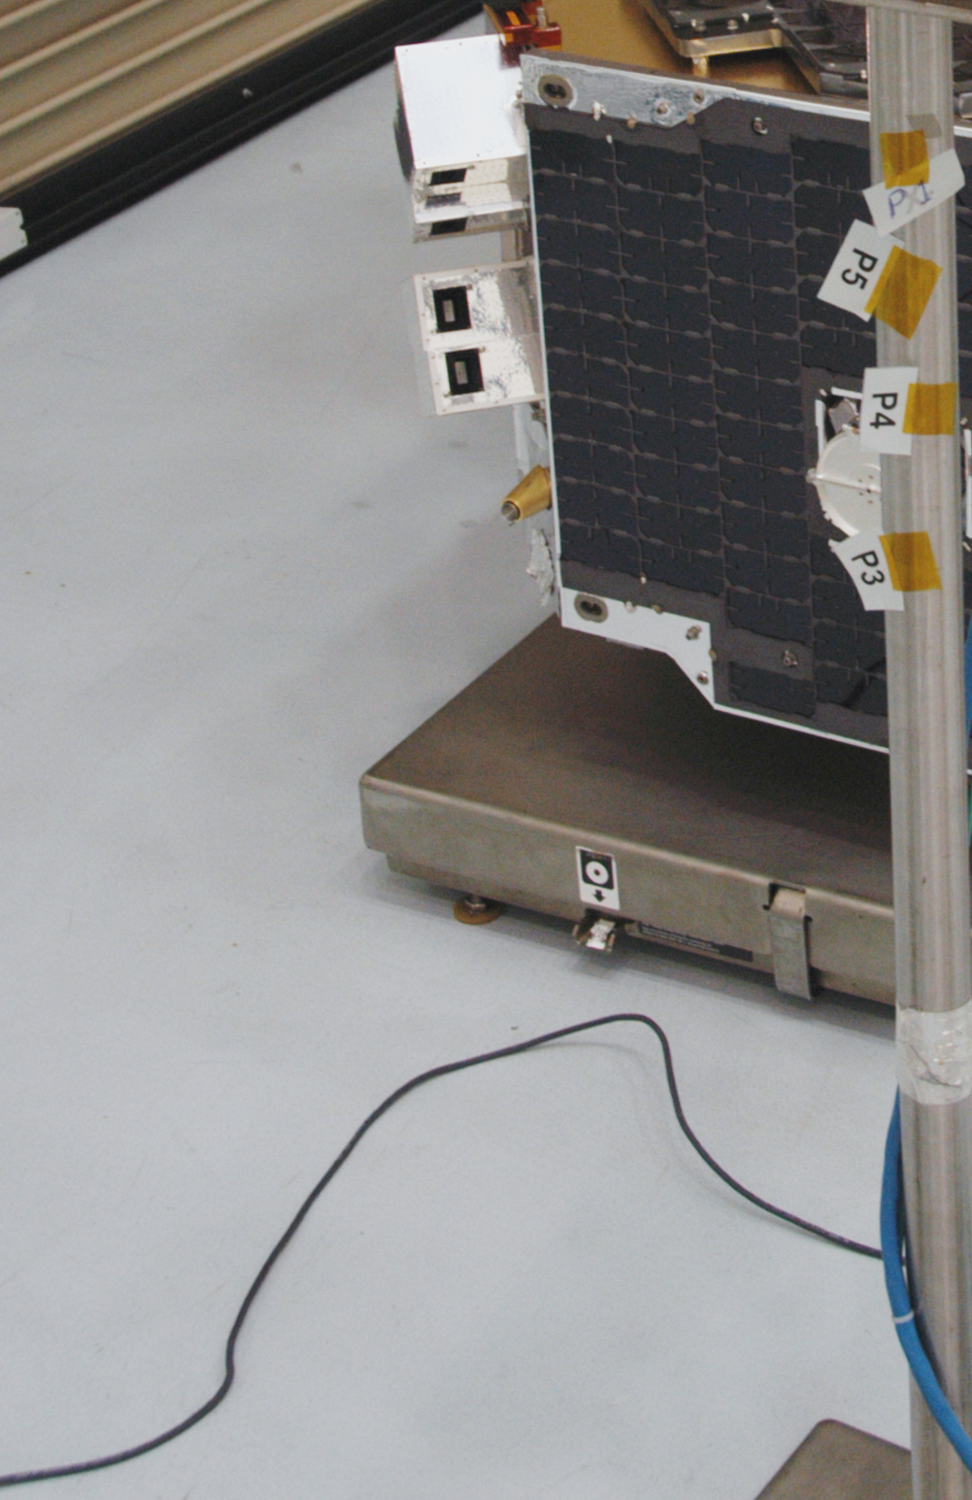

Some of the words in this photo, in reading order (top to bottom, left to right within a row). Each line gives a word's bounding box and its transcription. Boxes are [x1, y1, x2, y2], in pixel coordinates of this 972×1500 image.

[841, 248, 878, 290] P5
[870, 392, 898, 429] P4
[851, 549, 885, 586] P3
